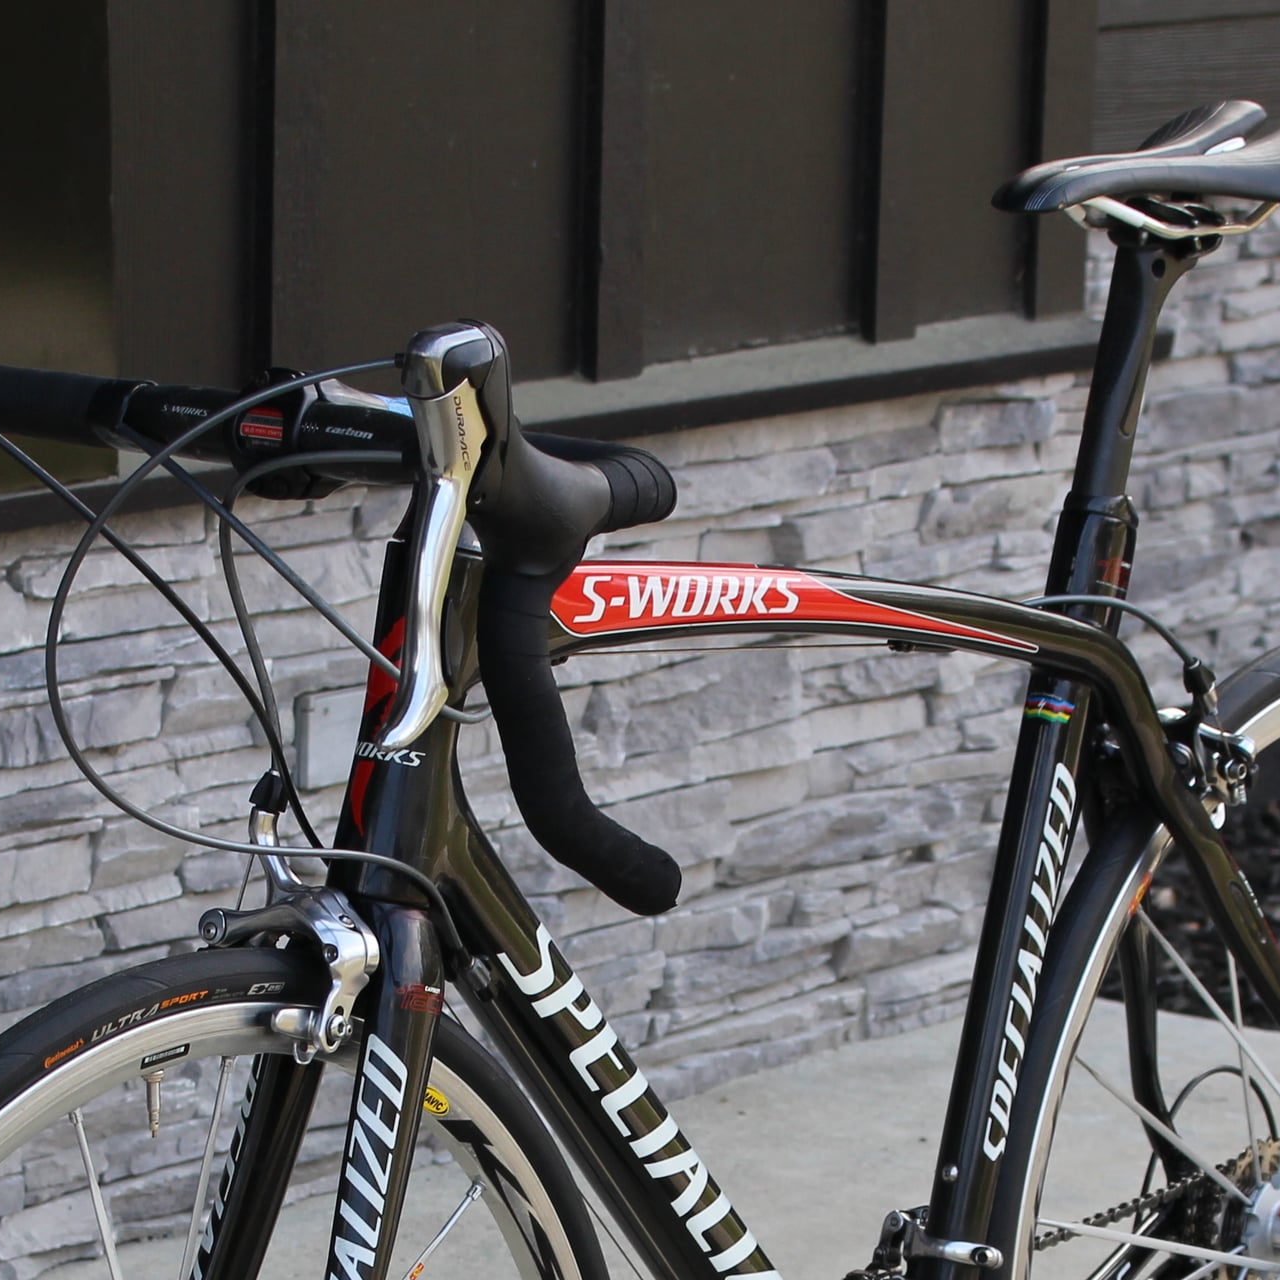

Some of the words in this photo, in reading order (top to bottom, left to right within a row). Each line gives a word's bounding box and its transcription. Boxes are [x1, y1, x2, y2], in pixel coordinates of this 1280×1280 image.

[324, 423, 375, 441] carbon
[572, 575, 802, 624] S-WORKS
[91, 1002, 160, 1043] ULTRA
[159, 990, 209, 1010] SPORT
